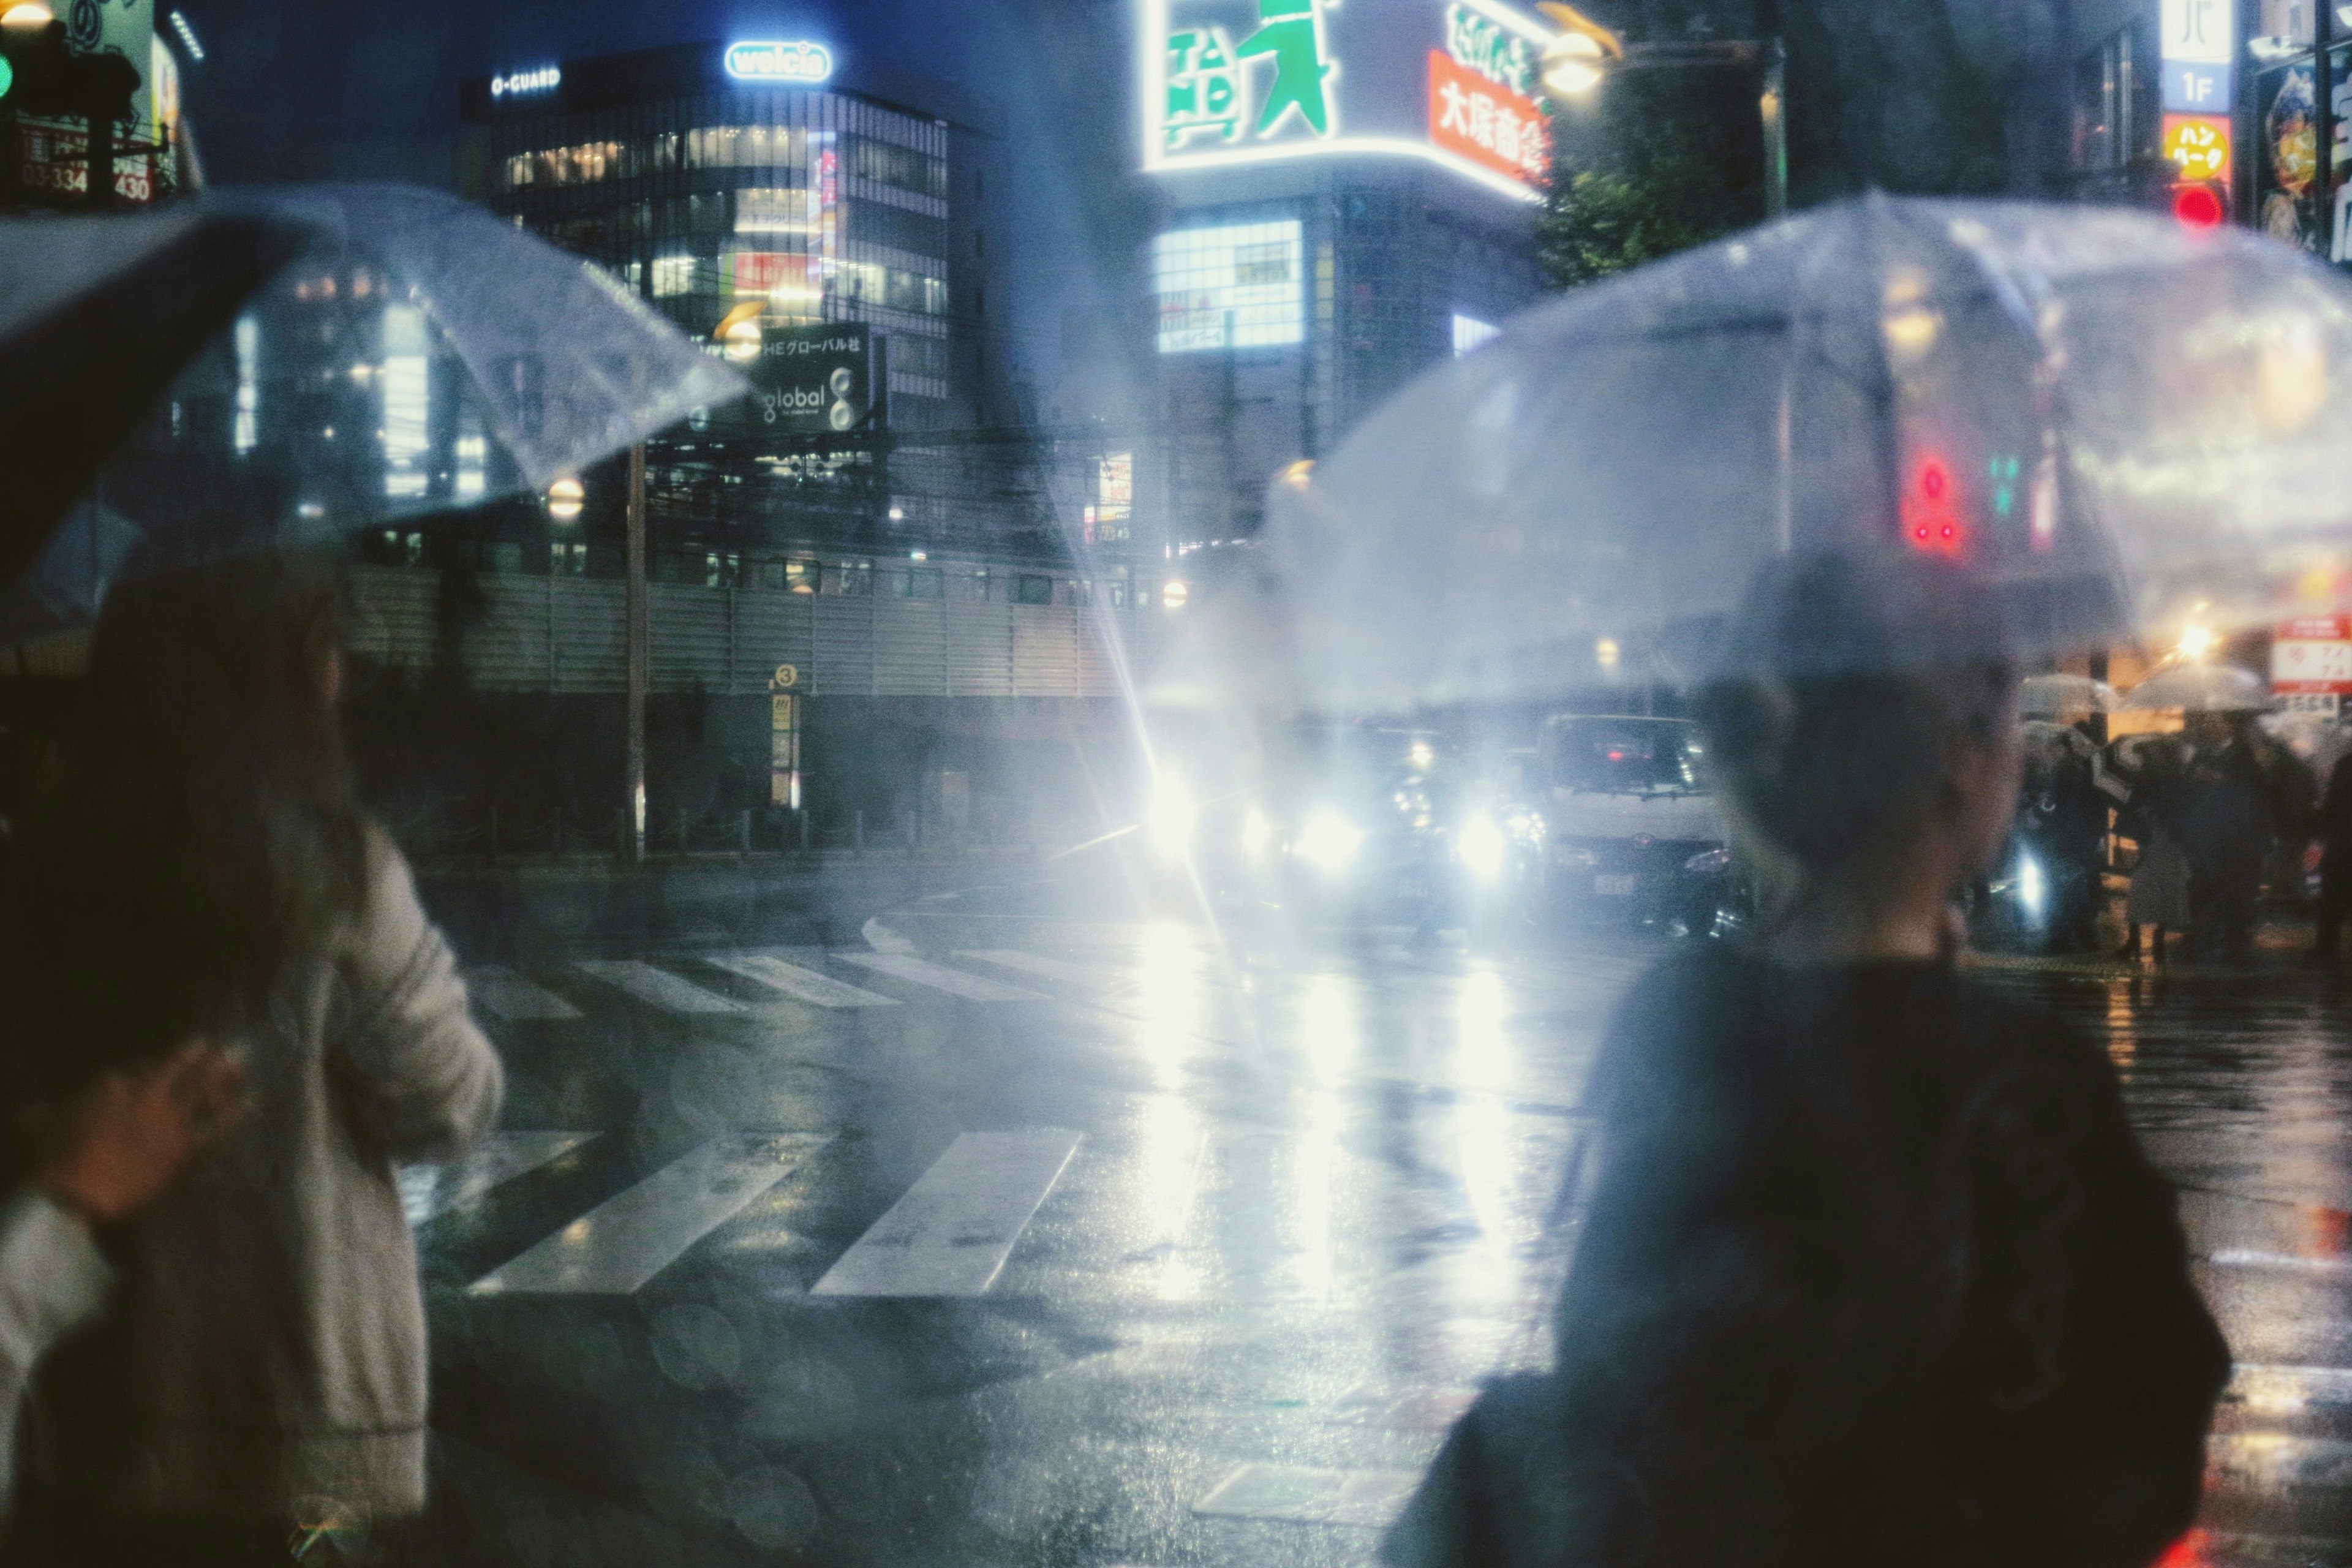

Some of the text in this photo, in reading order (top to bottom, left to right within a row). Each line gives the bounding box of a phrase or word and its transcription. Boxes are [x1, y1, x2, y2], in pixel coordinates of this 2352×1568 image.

[733, 42, 823, 75] welcia
[491, 68, 561, 96] O-GUARD
[2184, 72, 2214, 102] 1F
[1440, 81, 1545, 174] 大塚商会
[764, 337, 861, 355] HEグローバル社
[764, 384, 824, 423] global
